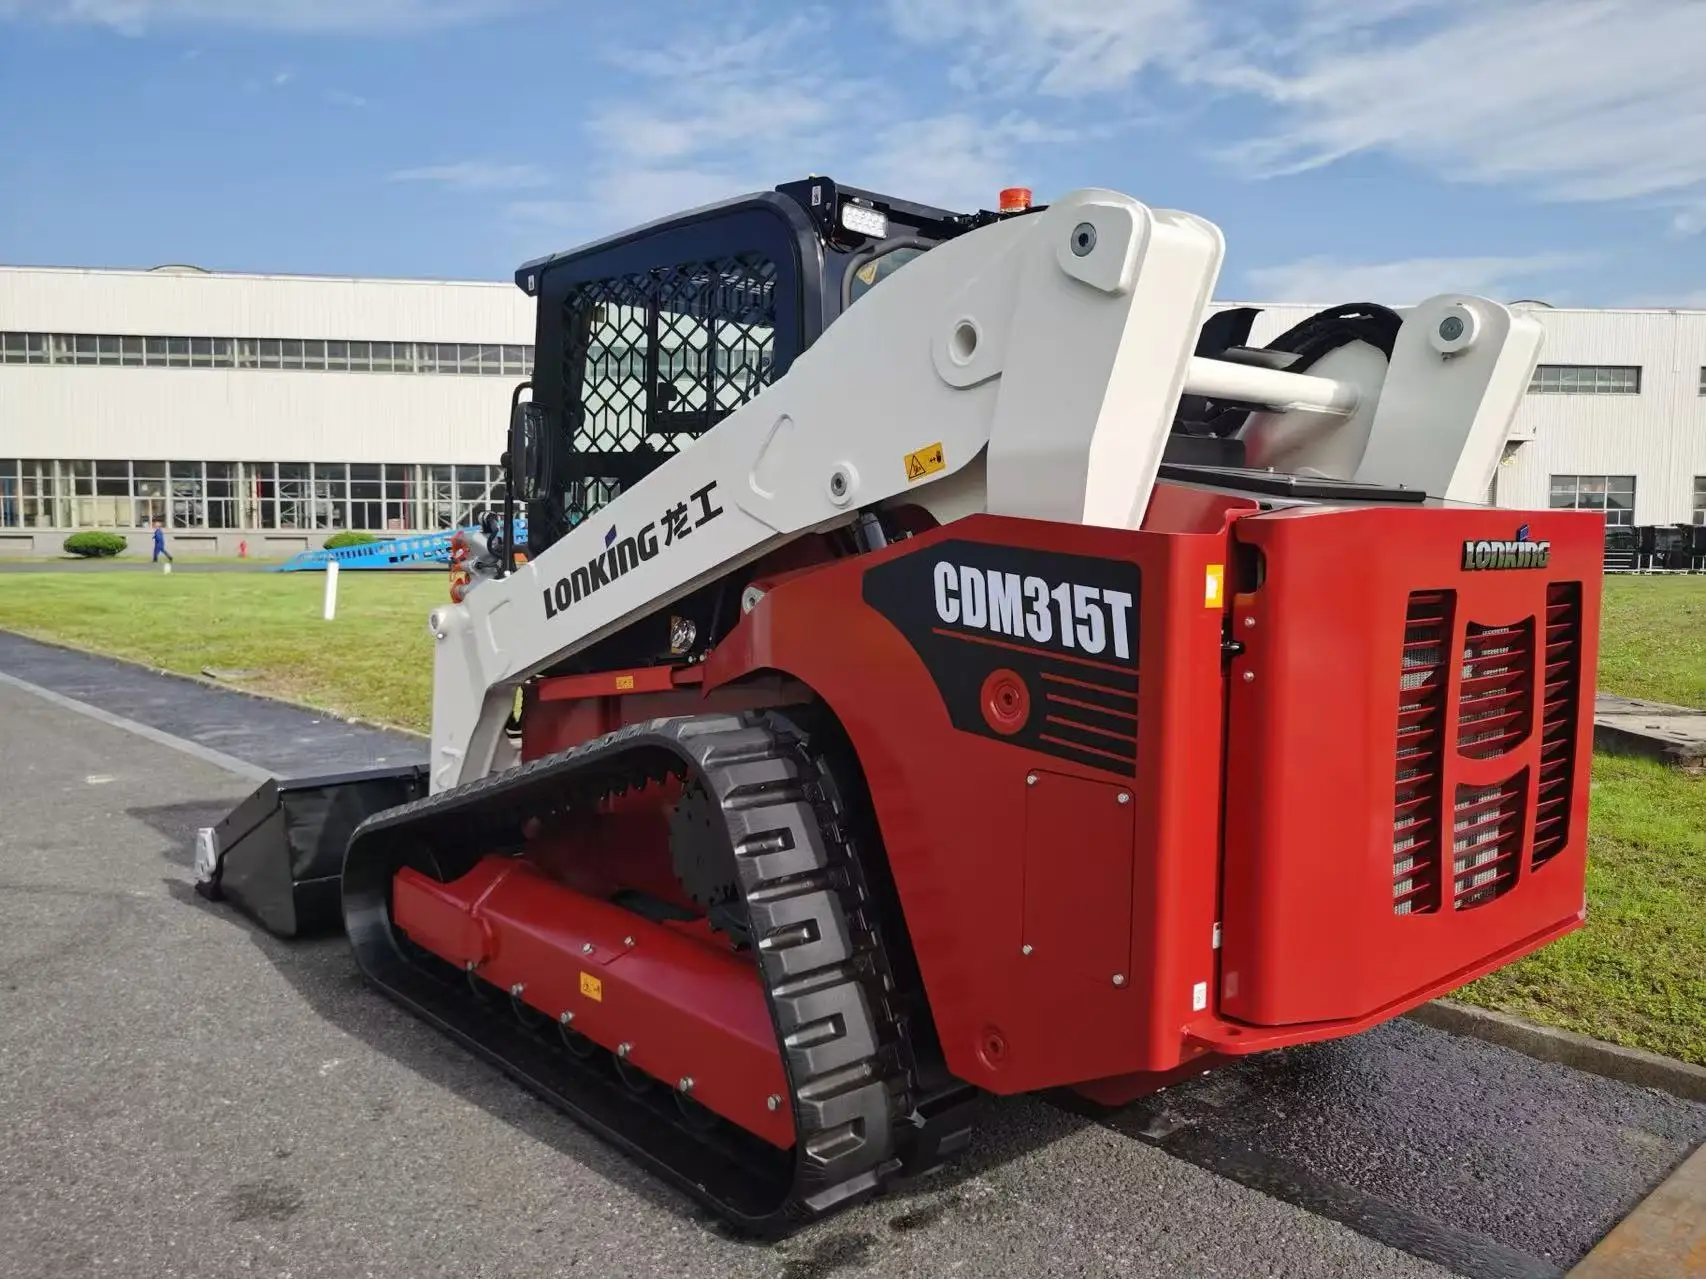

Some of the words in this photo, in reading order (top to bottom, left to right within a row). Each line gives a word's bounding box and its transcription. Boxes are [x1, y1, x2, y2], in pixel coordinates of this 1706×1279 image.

[543, 522, 660, 620] LONKING
[660, 480, 724, 547] 龙工
[1462, 525, 1551, 571] LONKING
[933, 561, 1133, 660] CDM315T
